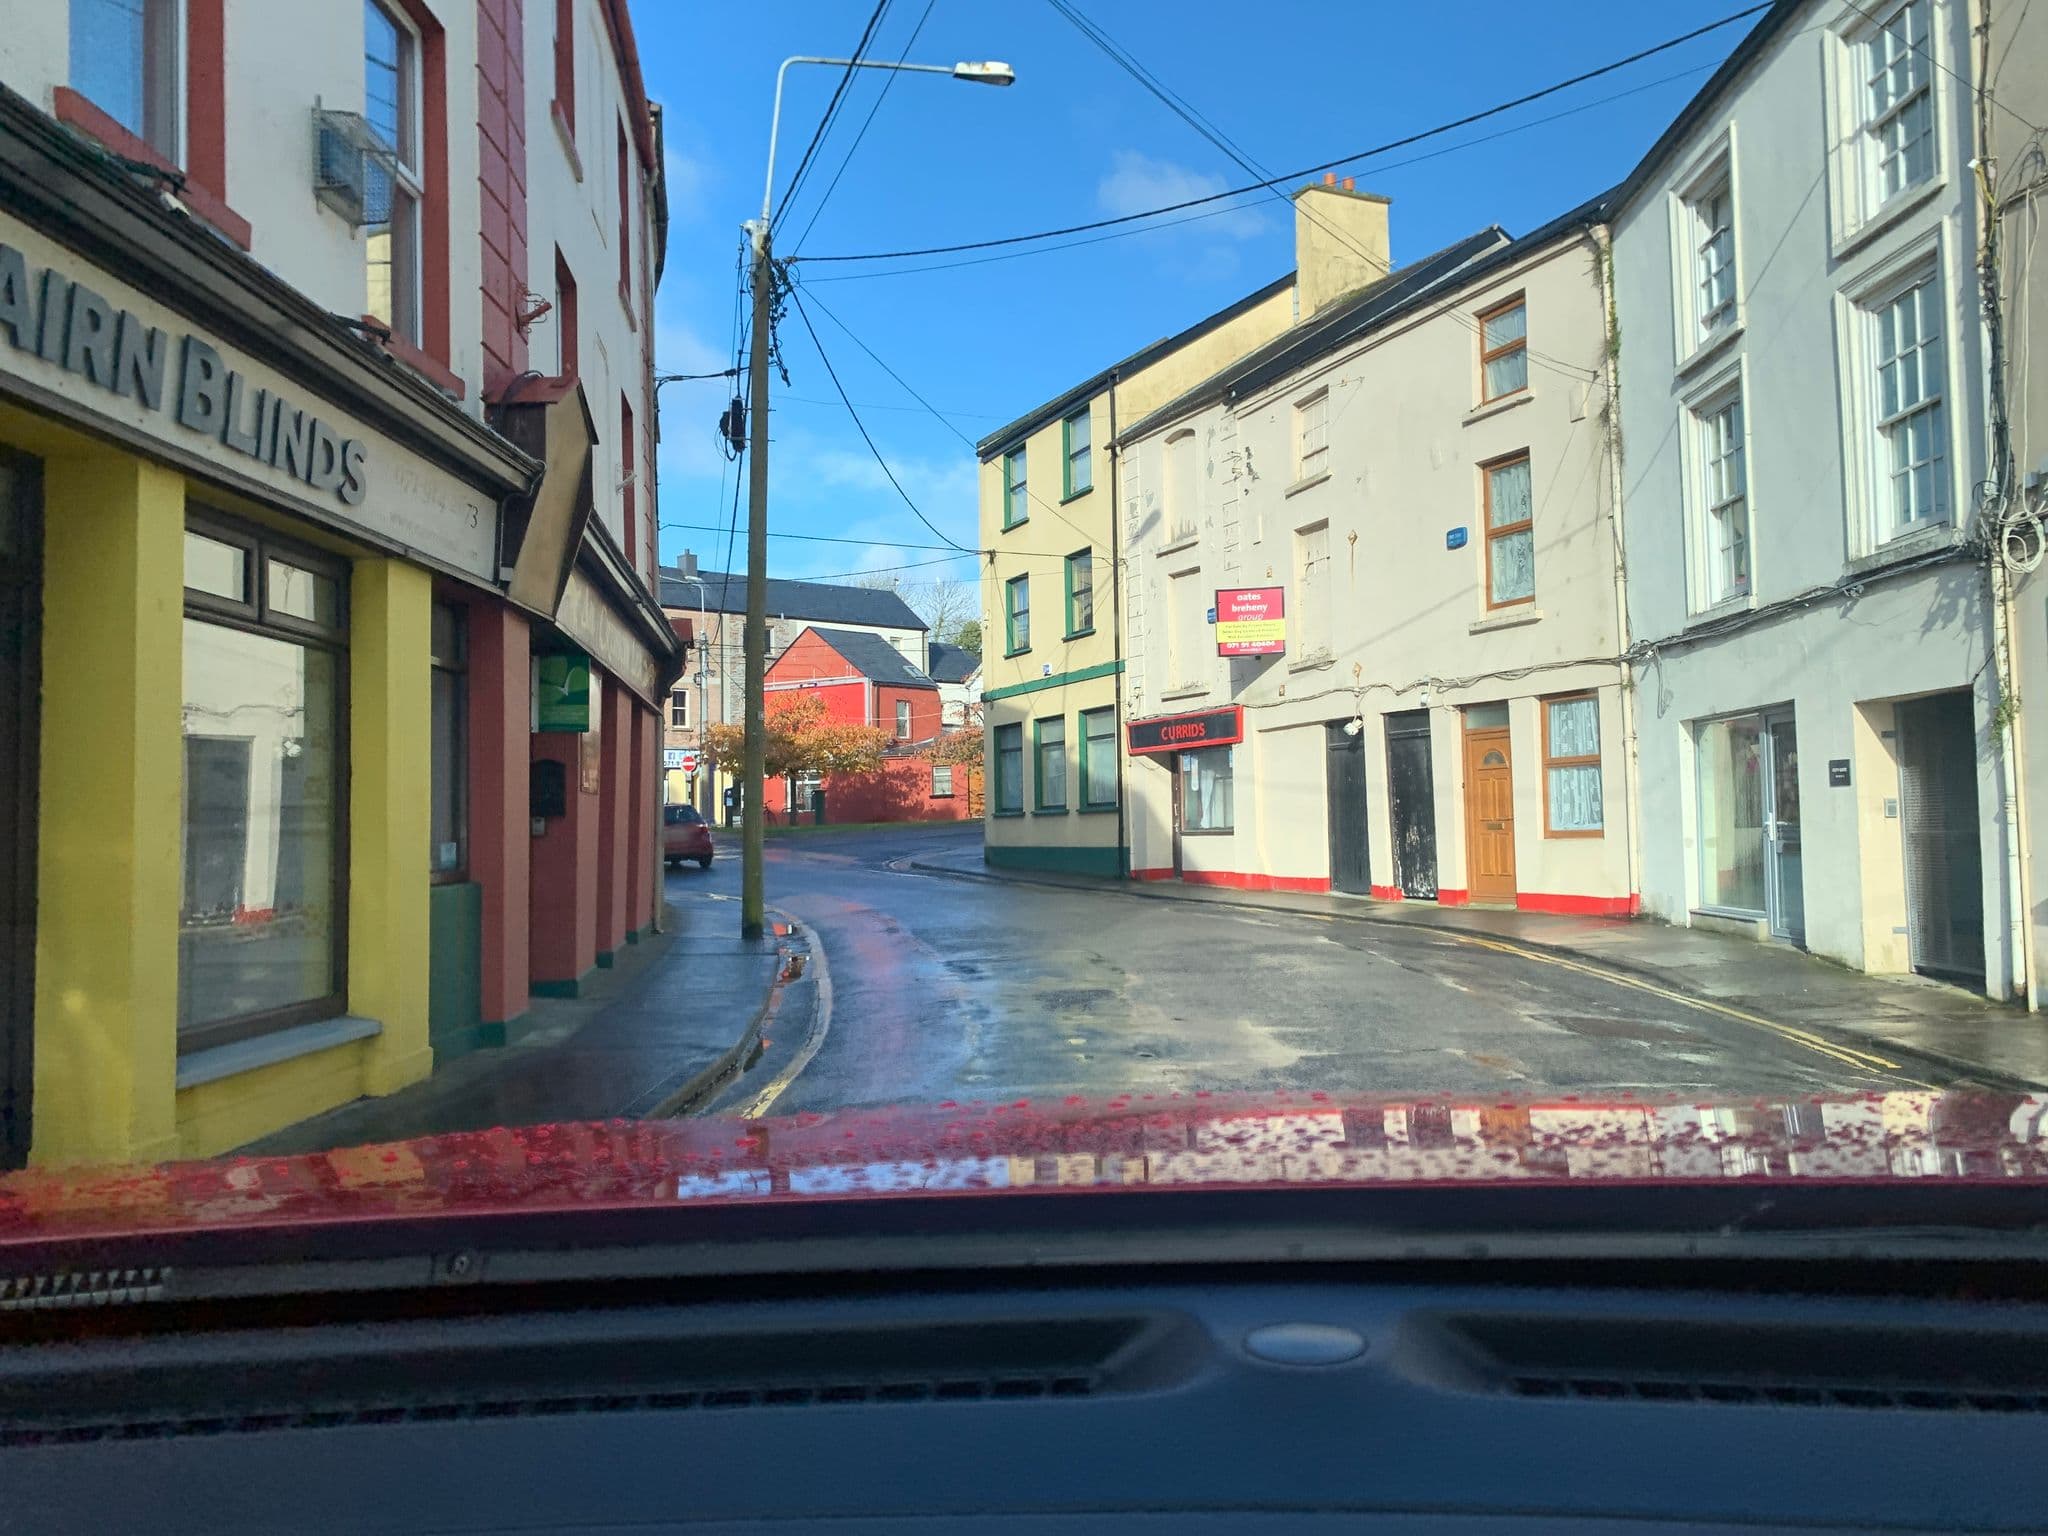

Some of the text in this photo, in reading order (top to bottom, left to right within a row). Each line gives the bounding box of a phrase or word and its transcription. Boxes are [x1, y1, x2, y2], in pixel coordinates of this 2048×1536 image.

[178, 334, 367, 505] BLINDS
[1236, 593, 1262, 601] oates
[1231, 604, 1268, 613] breheny
[1161, 722, 1206, 740] CURRIDS
